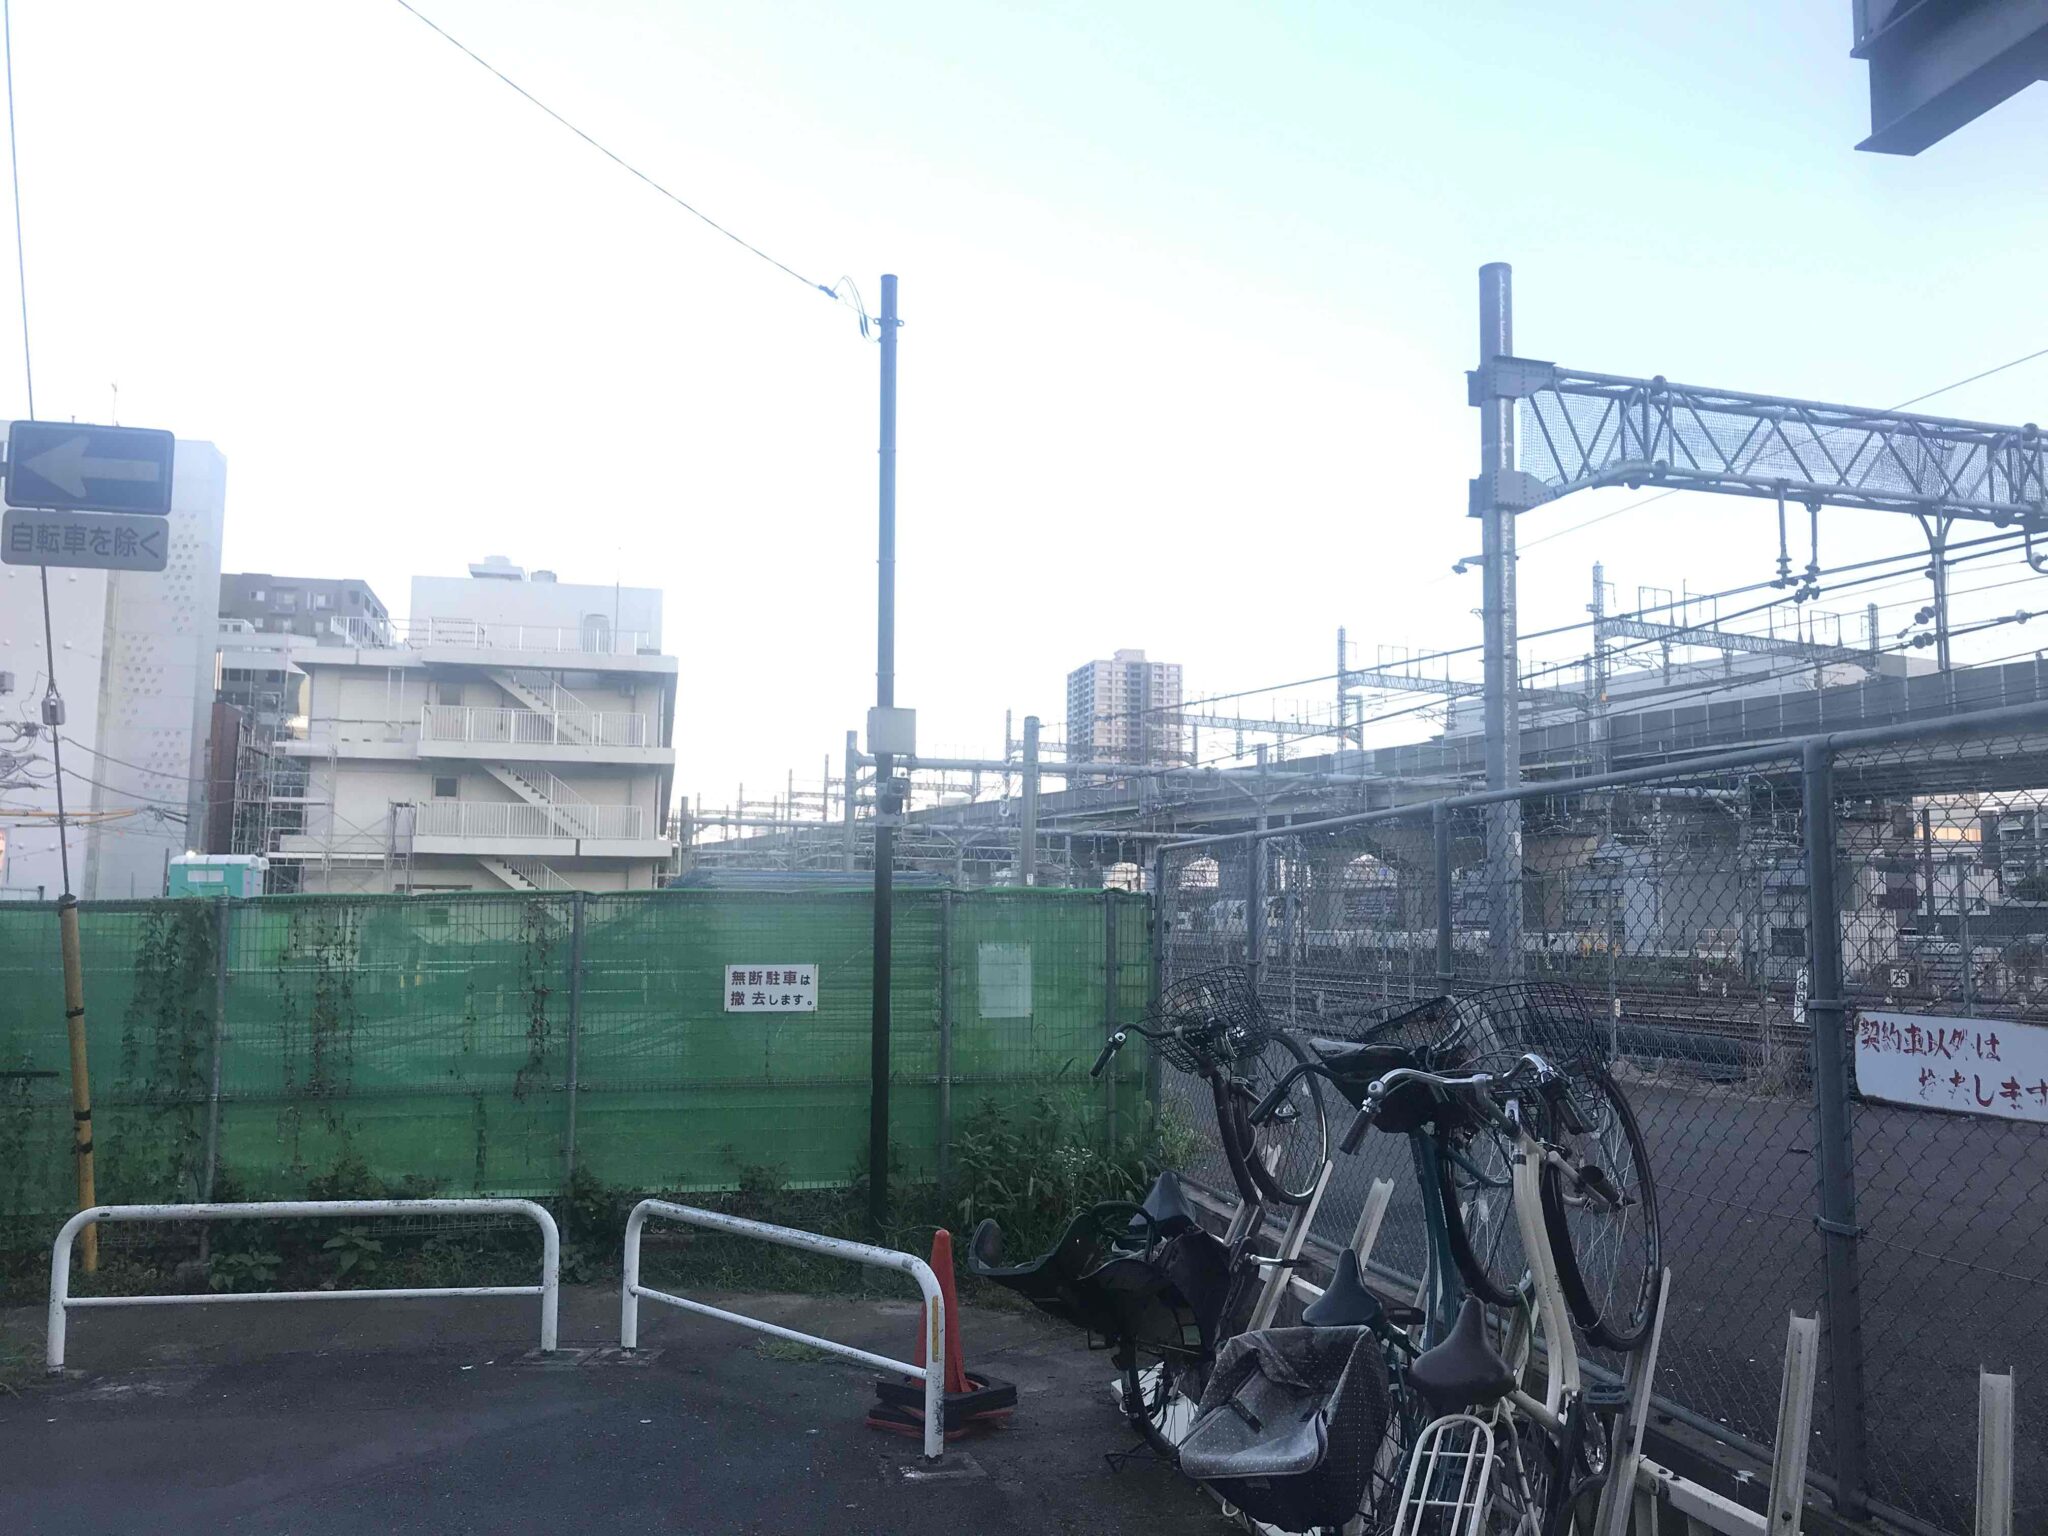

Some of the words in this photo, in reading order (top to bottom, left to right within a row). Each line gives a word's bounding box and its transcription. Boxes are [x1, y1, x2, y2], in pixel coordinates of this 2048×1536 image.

[11, 522, 161, 559] 自転車を除く
[731, 970, 811, 986] 無断駐車は
